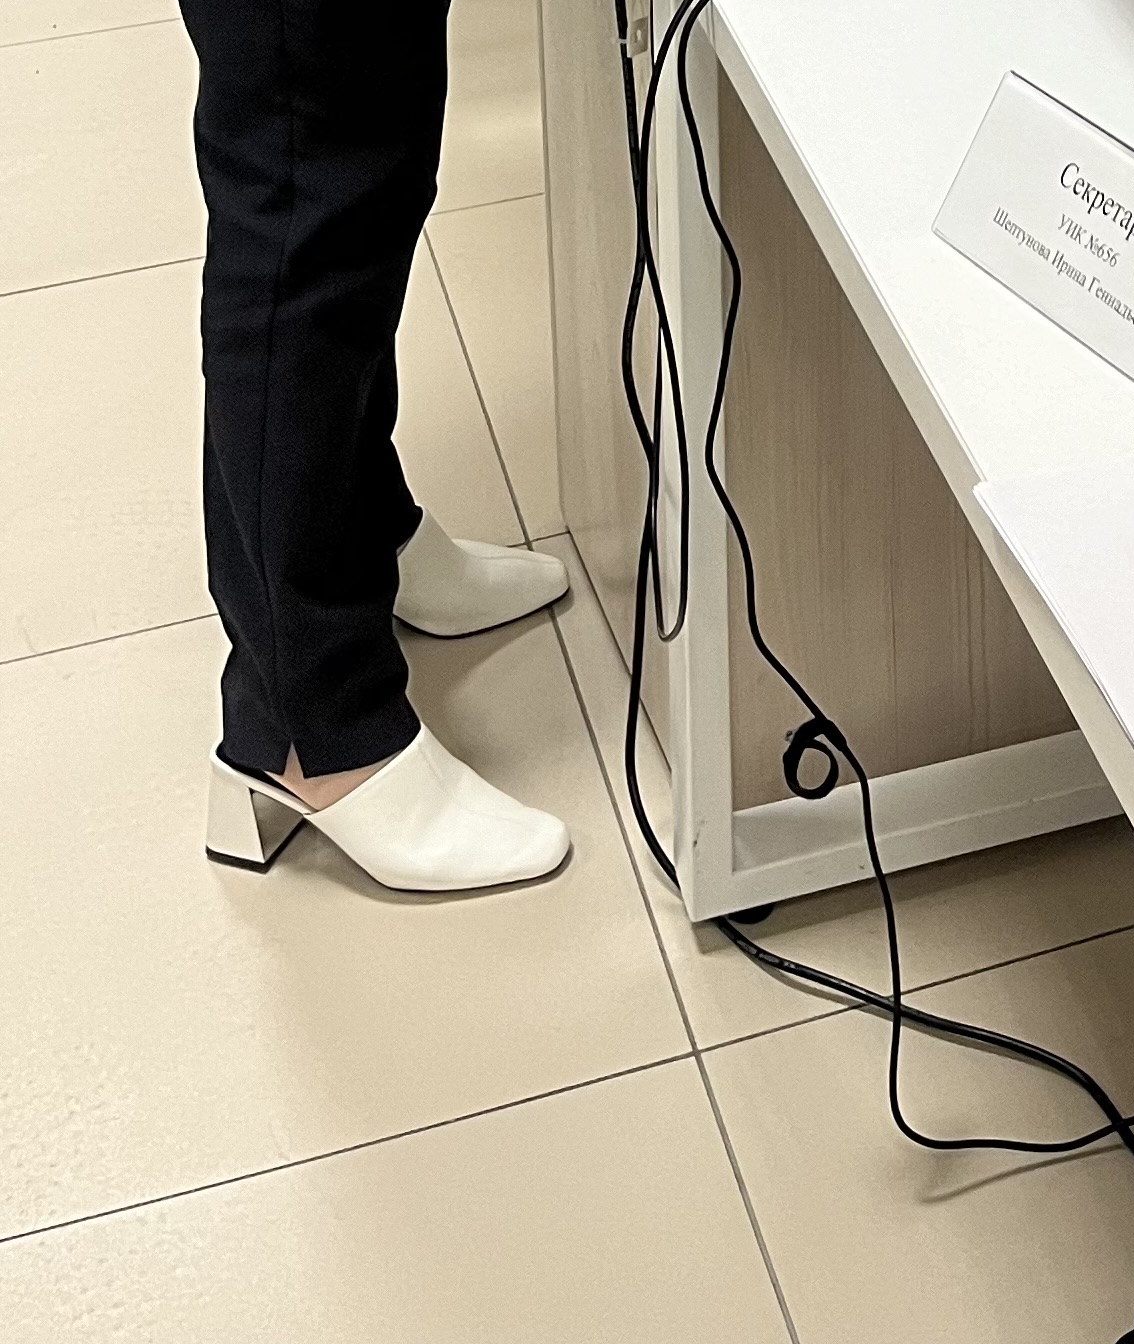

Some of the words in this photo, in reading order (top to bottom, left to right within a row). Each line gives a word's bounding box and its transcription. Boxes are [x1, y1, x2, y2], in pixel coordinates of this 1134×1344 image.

[992, 206, 1051, 262] Шептунова
[1051, 249, 1086, 288] Ирина
[1056, 213, 1087, 247] УИК
[1084, 235, 1119, 269] №656
